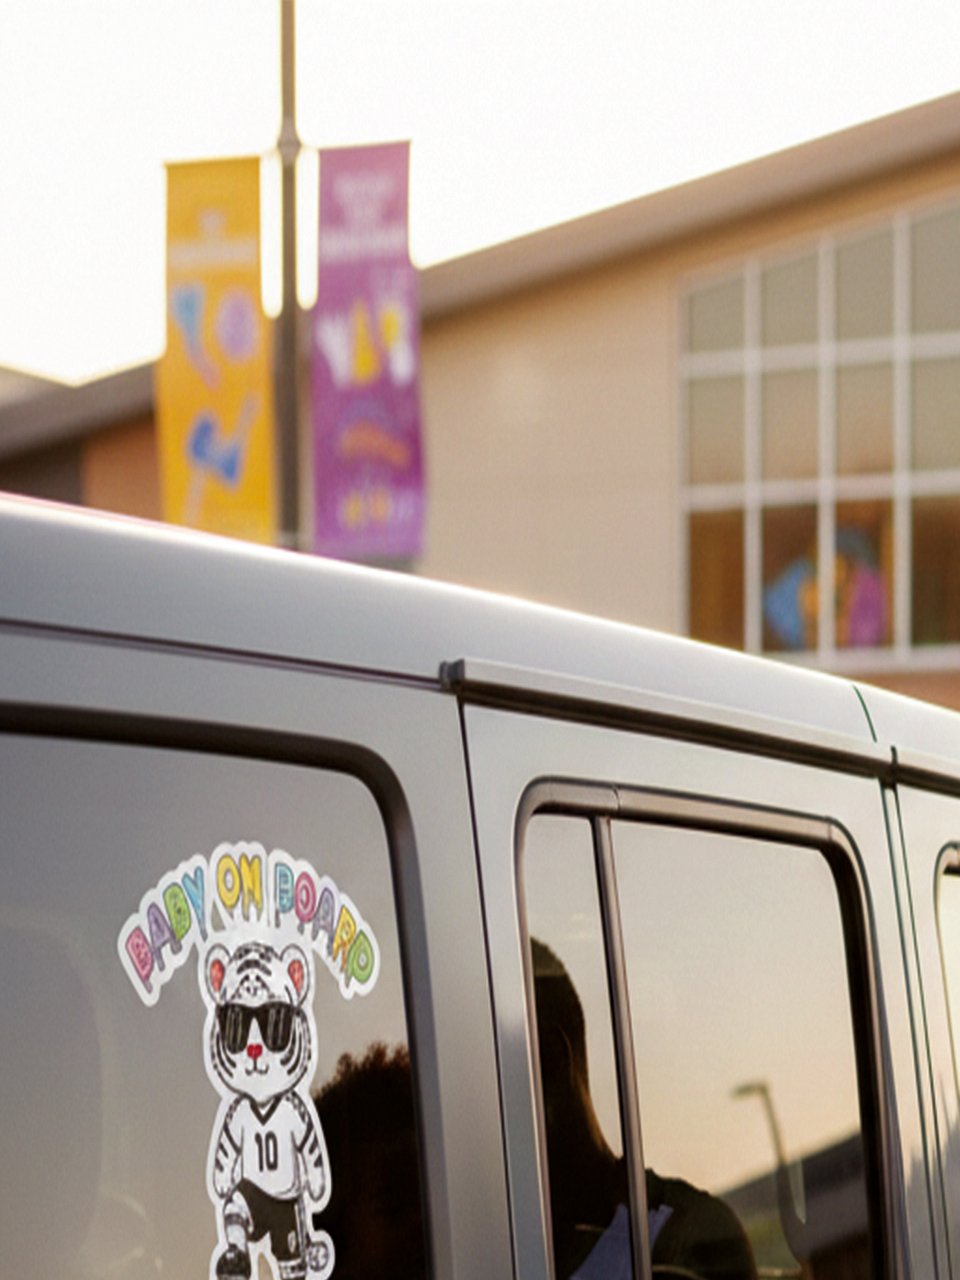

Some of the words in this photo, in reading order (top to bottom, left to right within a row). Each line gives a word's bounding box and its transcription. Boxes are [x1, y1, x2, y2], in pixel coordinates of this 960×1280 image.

[125, 866, 209, 993] BABY
[216, 853, 264, 921] ON
[274, 862, 375, 988] BOARD
[254, 1130, 278, 1172] 10
